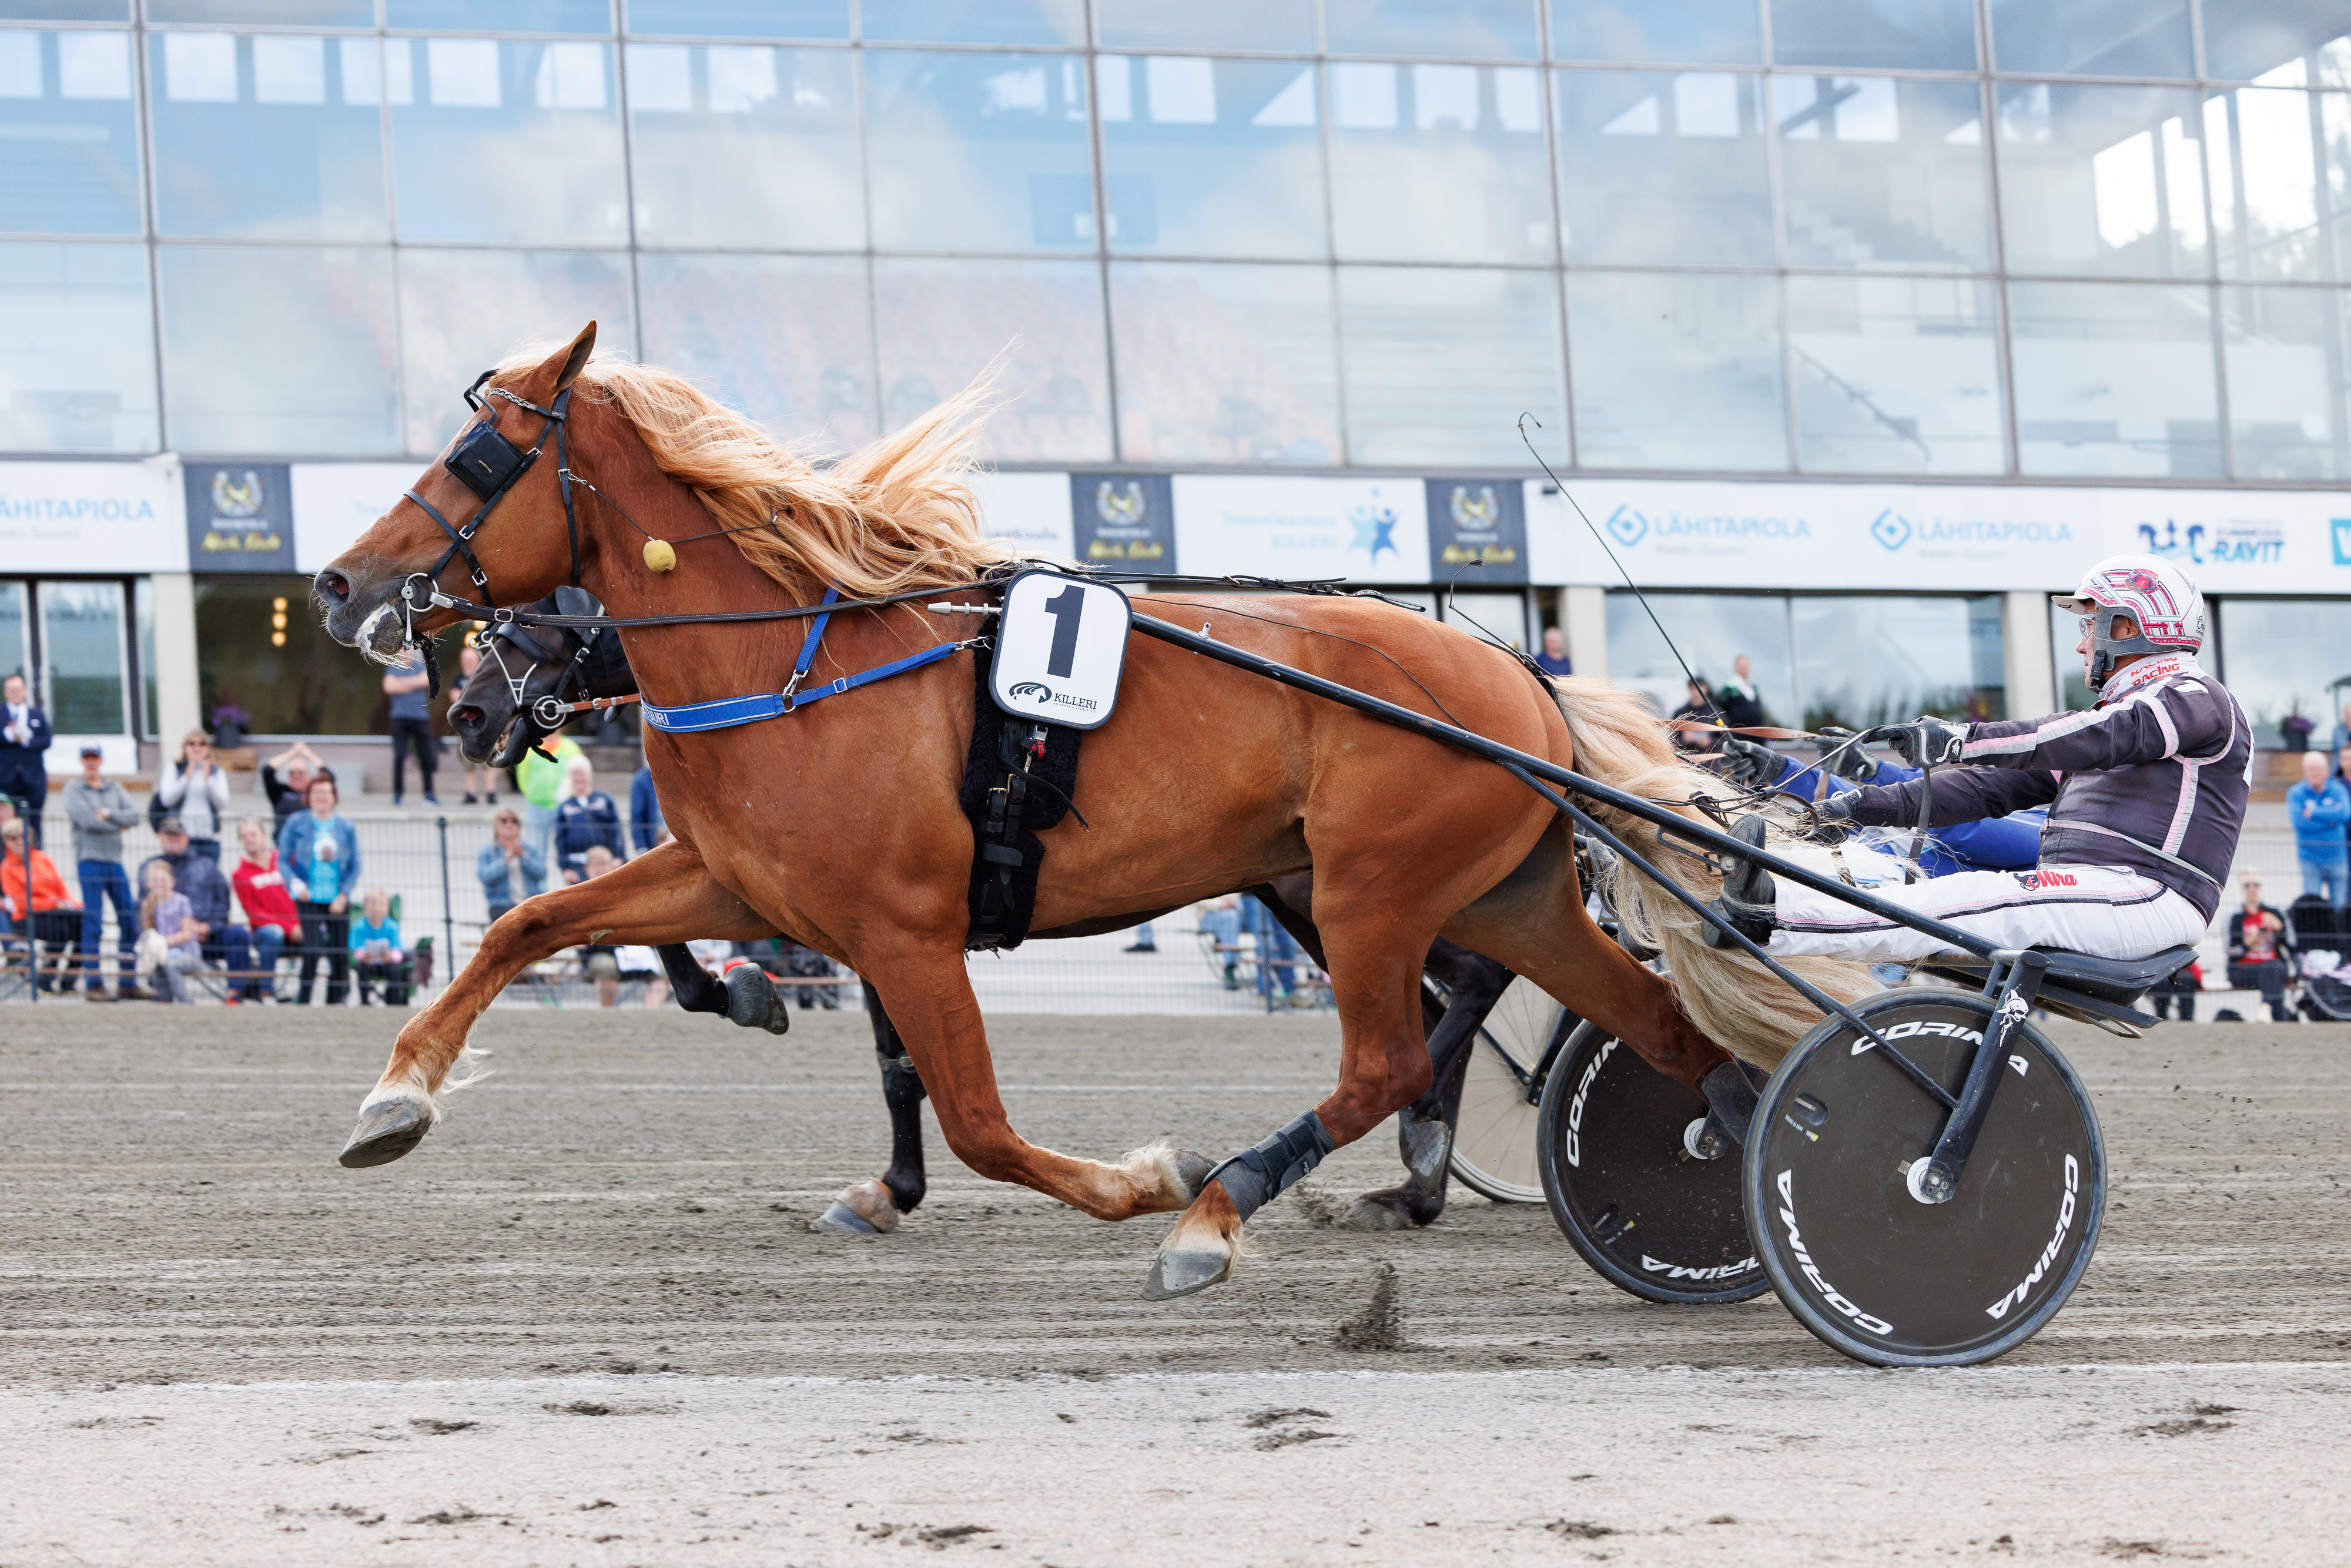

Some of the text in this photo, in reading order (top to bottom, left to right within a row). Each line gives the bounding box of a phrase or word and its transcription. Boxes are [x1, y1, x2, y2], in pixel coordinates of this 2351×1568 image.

[1654, 511, 1812, 539] LÄHITAPIOLA
[1917, 516, 2074, 544] LÄHITAPIOLA
[1044, 584, 1086, 679] 1
[2131, 663, 2180, 686] RACING
[643, 705, 670, 726] TUURI
[1054, 693, 1097, 710] KILLERI
[2028, 870, 2077, 889] Mira
[1566, 1036, 1623, 1168] CORIM
[1985, 1153, 2079, 1320] CORIMA
[1777, 1168, 1894, 1335] CORIMA
[1642, 1254, 1760, 1280] RIMA
